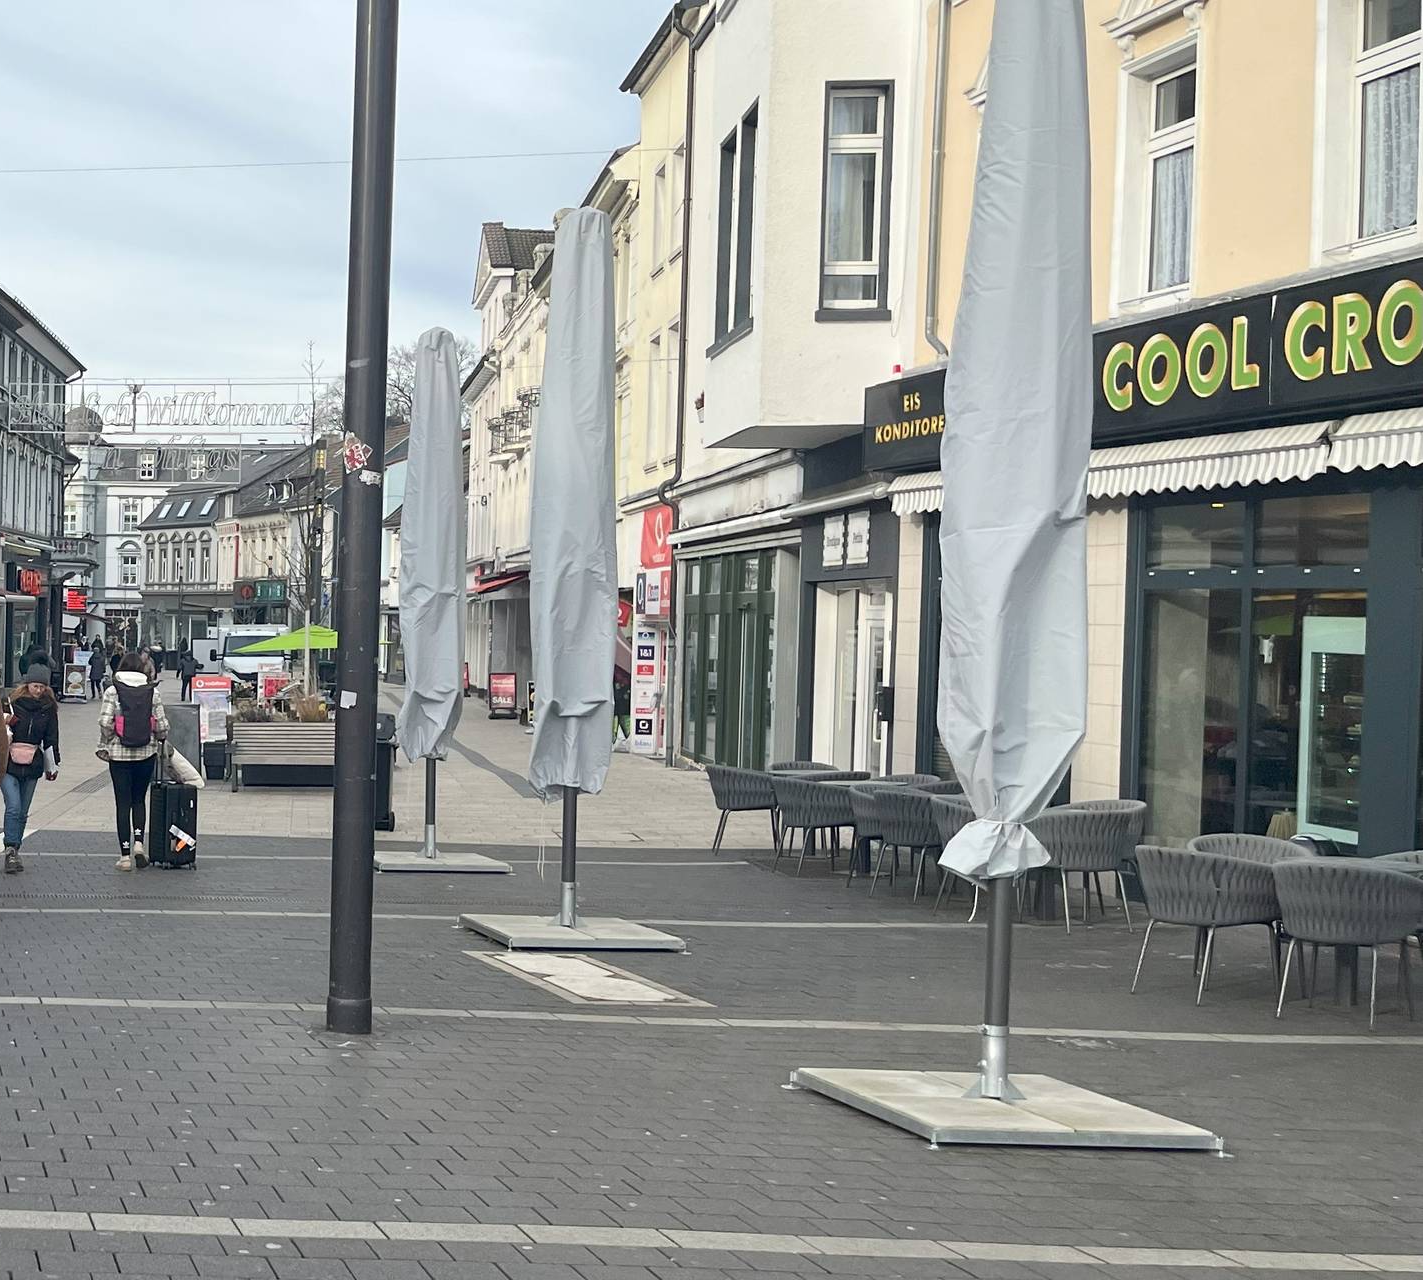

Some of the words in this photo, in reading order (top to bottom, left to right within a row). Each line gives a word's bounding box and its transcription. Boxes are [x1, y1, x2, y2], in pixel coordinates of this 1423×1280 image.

[1102, 315, 1260, 412] COOL
[1284, 279, 1423, 381] CRO
[10, 391, 135, 427] Hlich
[903, 392, 921, 412] EIS
[639, 649, 653, 657] 1&1
[492, 696, 513, 704] SALE
